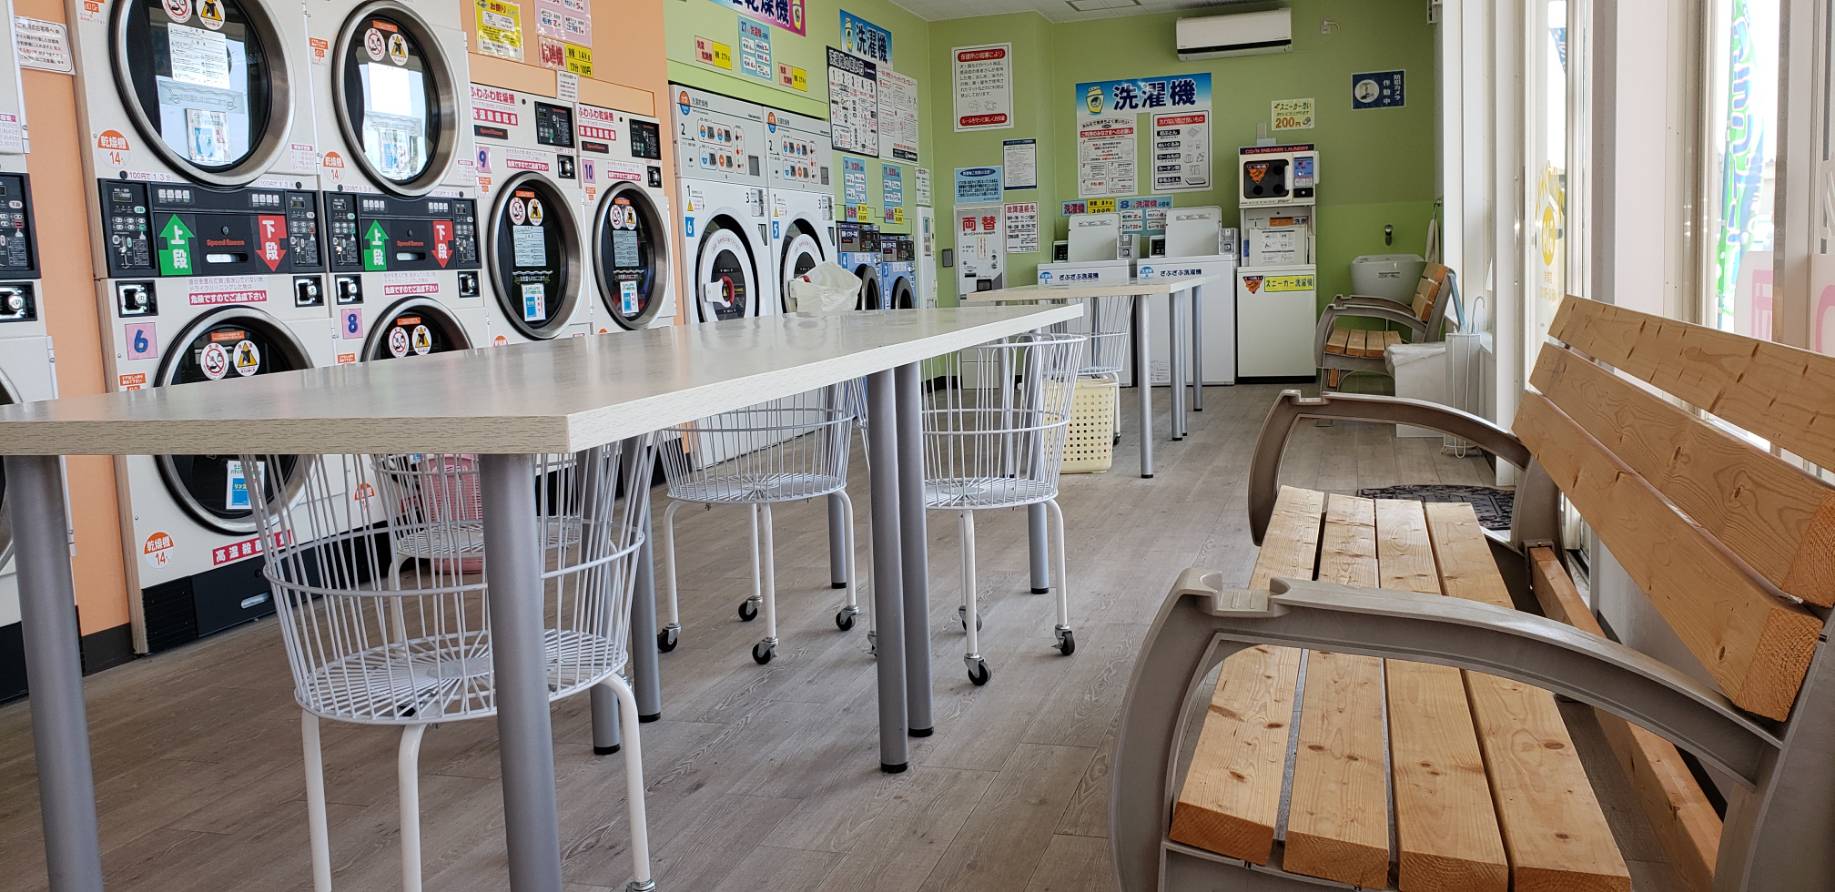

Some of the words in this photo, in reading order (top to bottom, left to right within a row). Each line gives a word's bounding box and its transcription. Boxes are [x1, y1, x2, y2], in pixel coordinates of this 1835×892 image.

[856, 23, 889, 63] 洗濯機
[1113, 79, 1196, 110] 洗濯機
[1275, 117, 1302, 129] 200円
[110, 151, 121, 164] 14
[479, 150, 486, 168] 9
[332, 169, 339, 180] 14
[584, 164, 593, 180] 10
[687, 223, 693, 233] 6
[773, 225, 778, 235] 5
[962, 216, 996, 231] 両替
[171, 225, 188, 269] 上段
[262, 220, 278, 260] 下段
[372, 229, 384, 266] 上段
[437, 225, 448, 259] 下段
[1266, 278, 1313, 287] スニーカー洗濯機
[349, 313, 359, 333] 8
[133, 329, 149, 353] 6
[155, 552, 166, 565] 14
